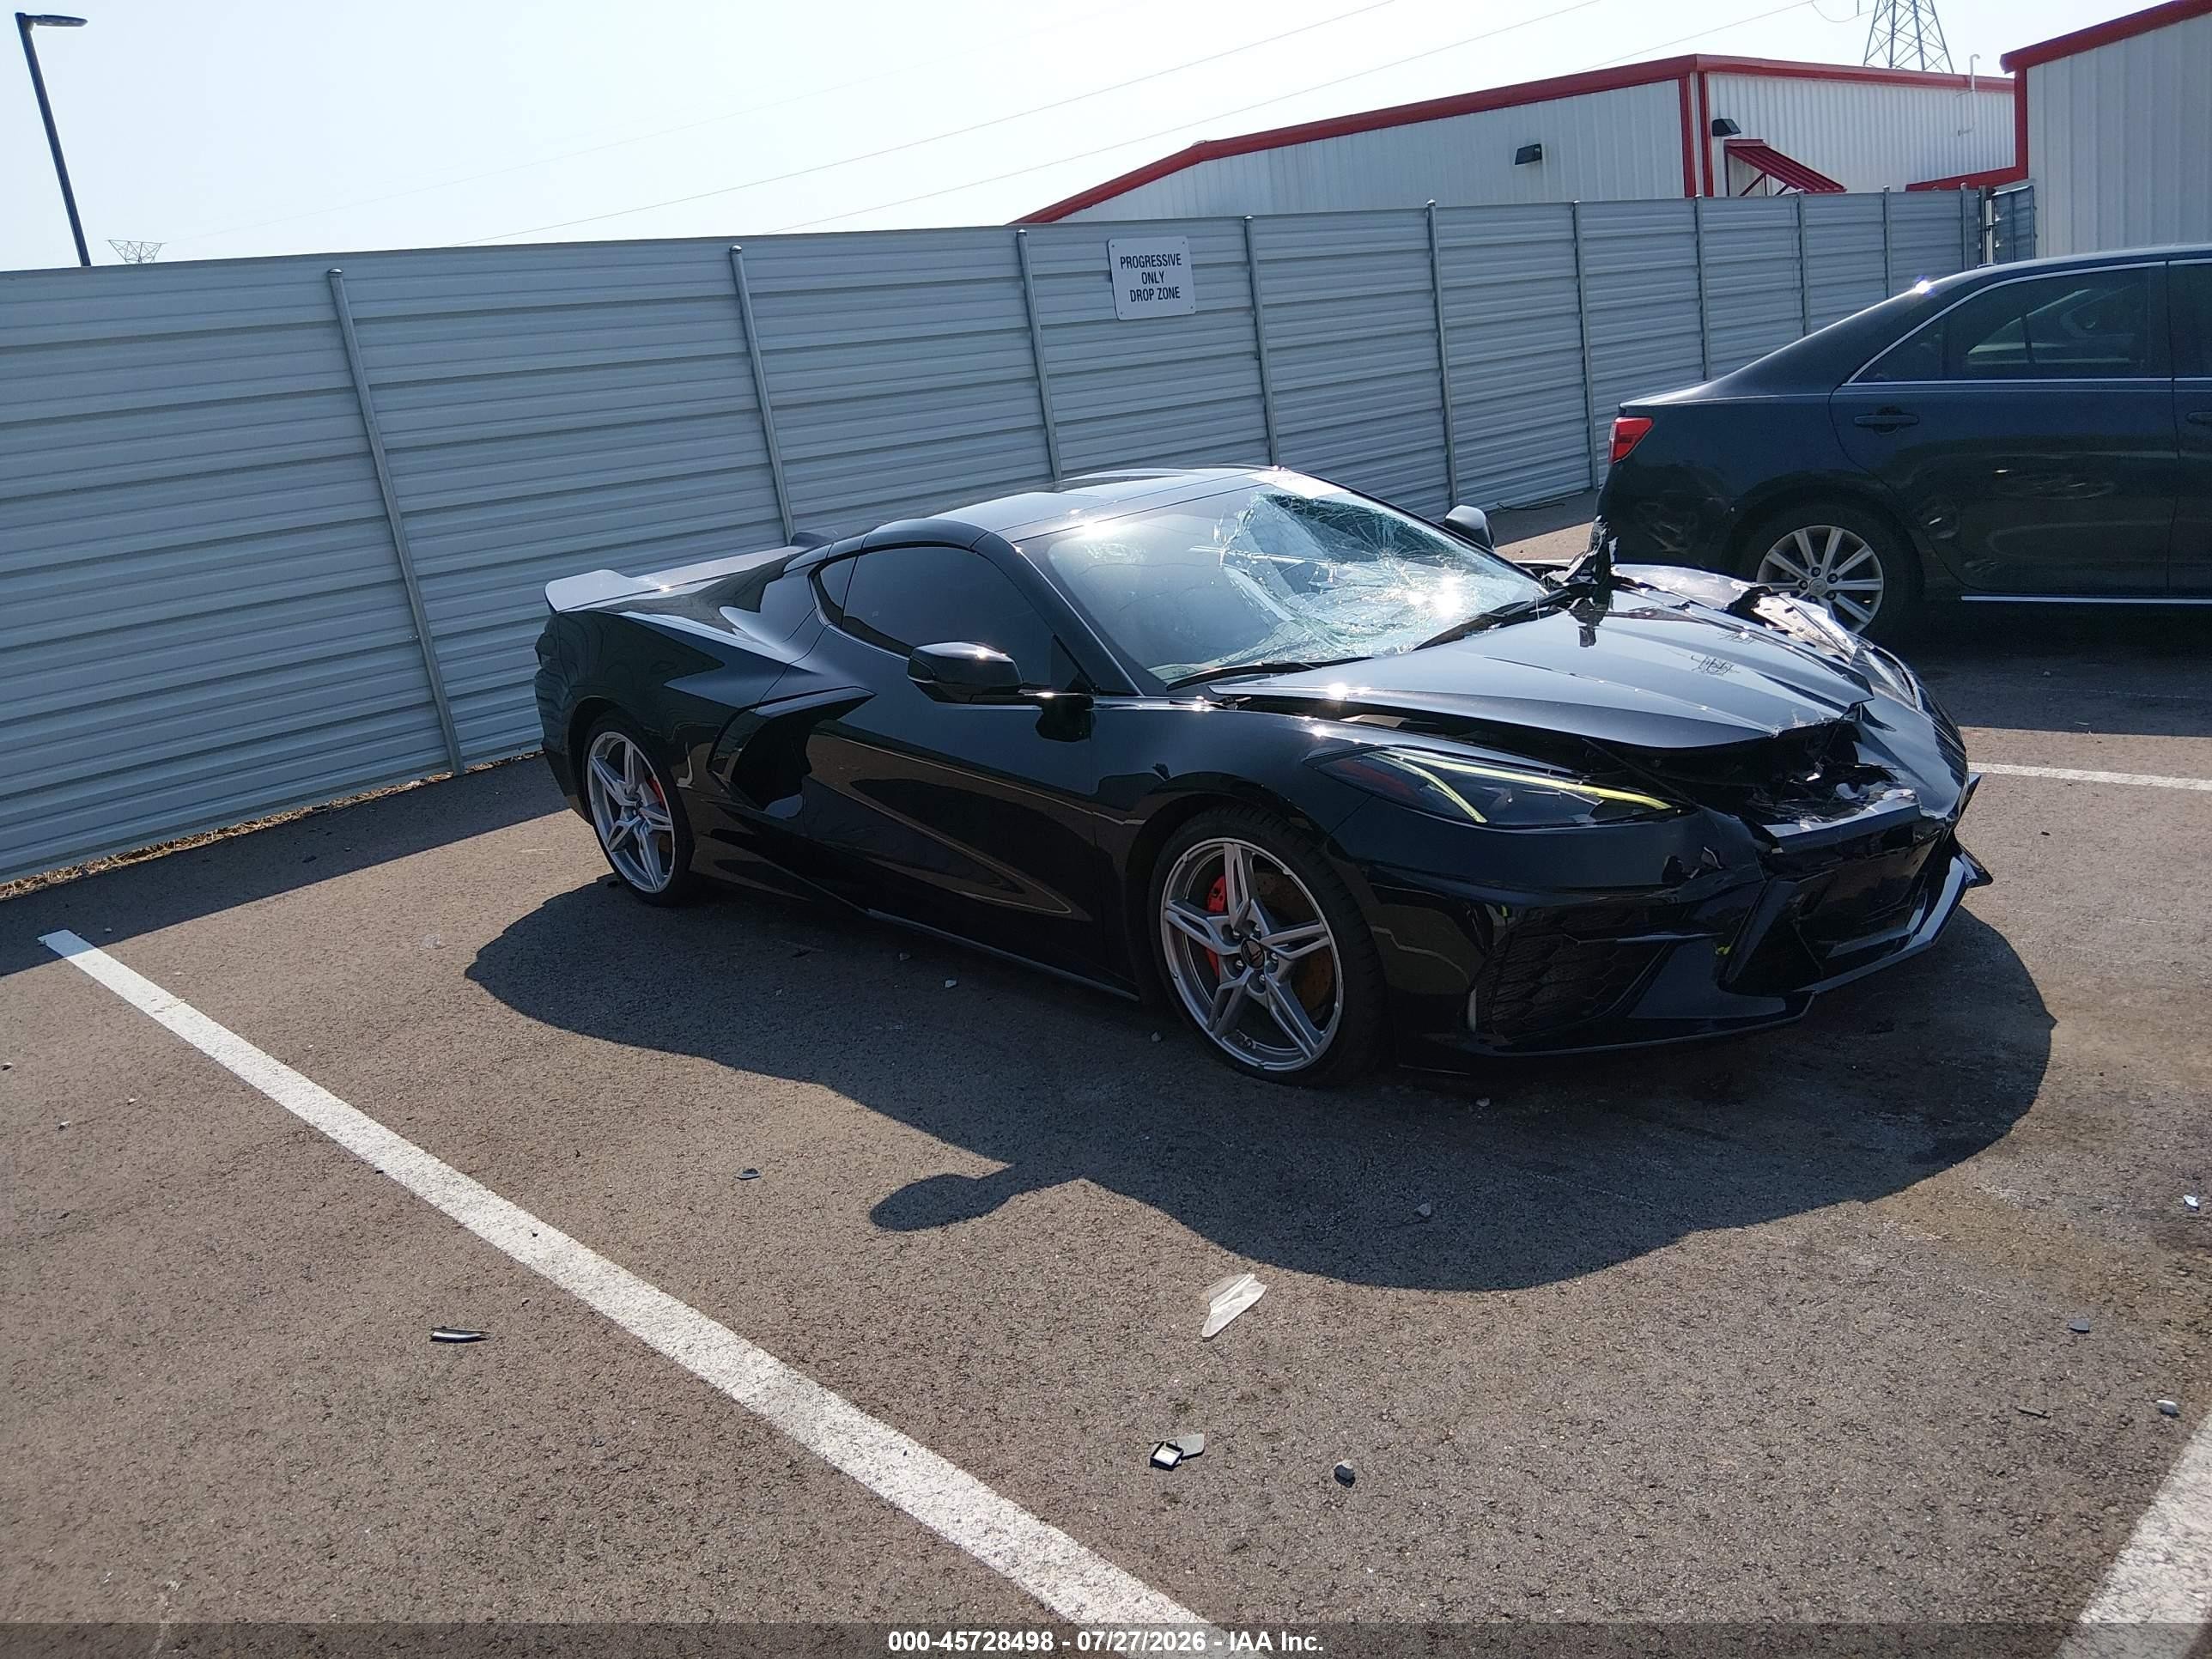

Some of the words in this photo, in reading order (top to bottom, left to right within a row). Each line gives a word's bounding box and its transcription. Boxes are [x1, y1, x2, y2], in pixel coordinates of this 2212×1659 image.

[1120, 253, 1182, 270] PROGRESSIVE
[1141, 270, 1164, 284] ONLY
[1129, 288, 1155, 302] DROP
[1157, 286, 1181, 300] ZONE
